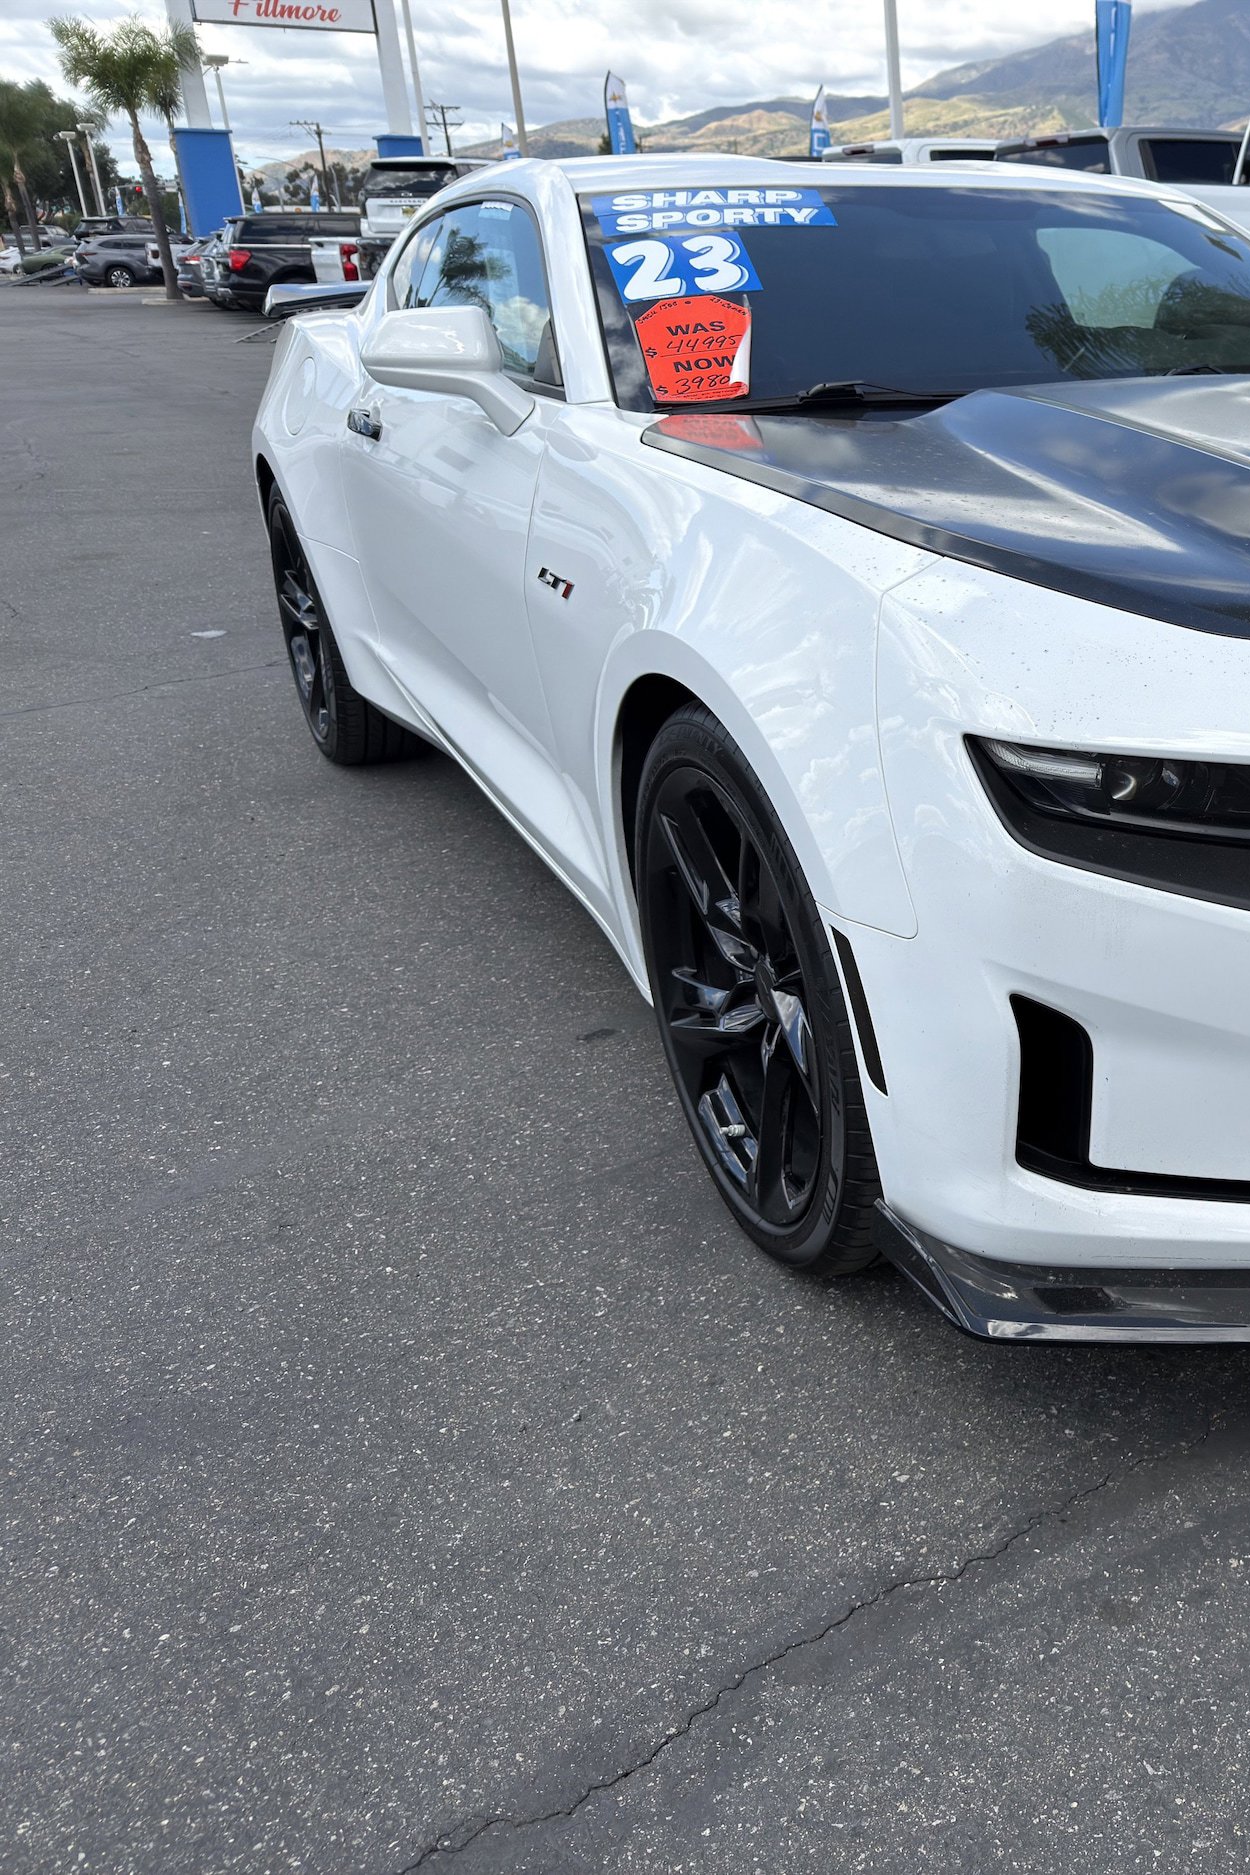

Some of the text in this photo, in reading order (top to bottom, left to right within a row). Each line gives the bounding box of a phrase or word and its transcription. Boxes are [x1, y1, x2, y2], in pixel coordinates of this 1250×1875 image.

[228, 0, 341, 22] Fillmore
[611, 190, 802, 212] SHARP
[615, 207, 818, 233] SPORTY
[611, 235, 749, 301] 23
[666, 321, 726, 337] WAS
[645, 334, 743, 359] $ 44995
[673, 355, 736, 373] NOW
[655, 385, 669, 395] $
